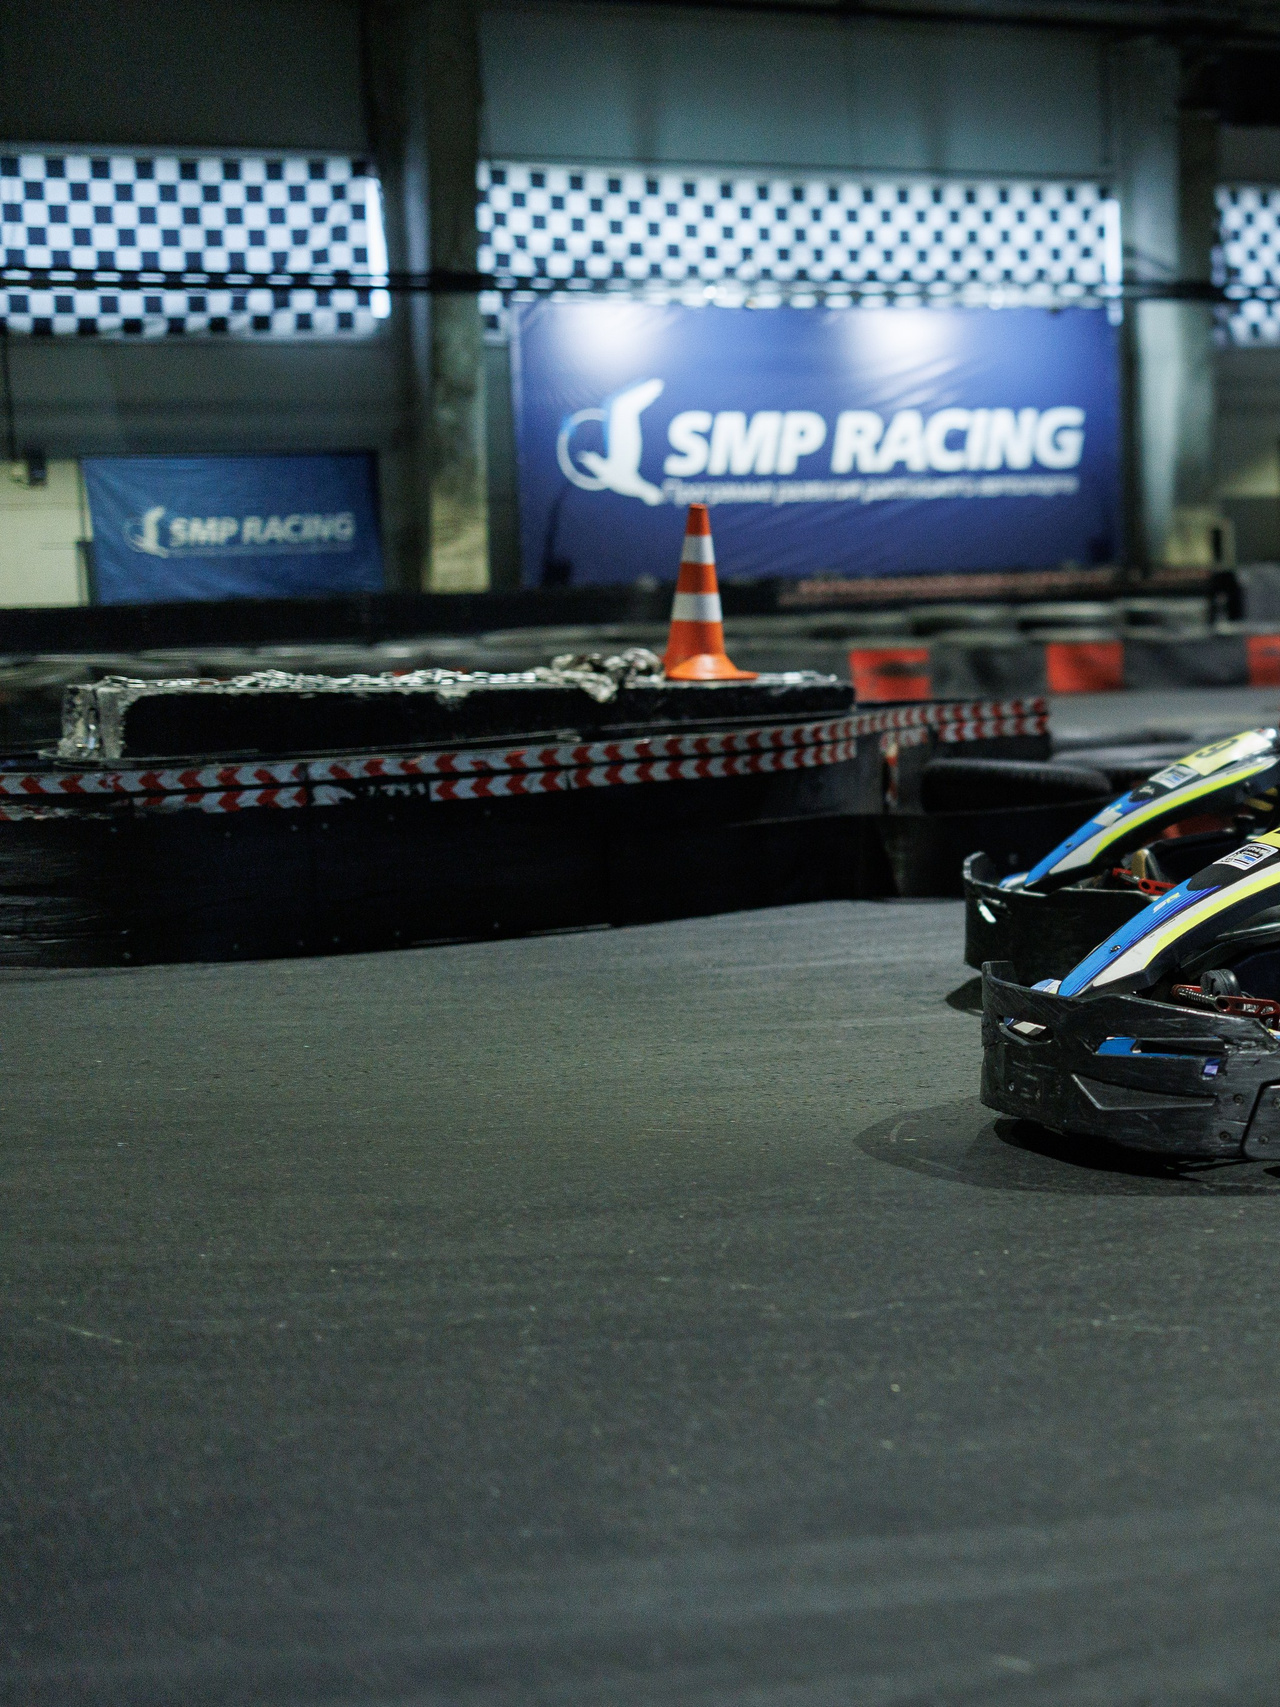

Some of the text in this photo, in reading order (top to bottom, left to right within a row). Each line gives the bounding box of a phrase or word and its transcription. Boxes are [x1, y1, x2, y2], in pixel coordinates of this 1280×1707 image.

[664, 406, 1086, 477] SMP RACING
[169, 511, 356, 547] SMP RACING
